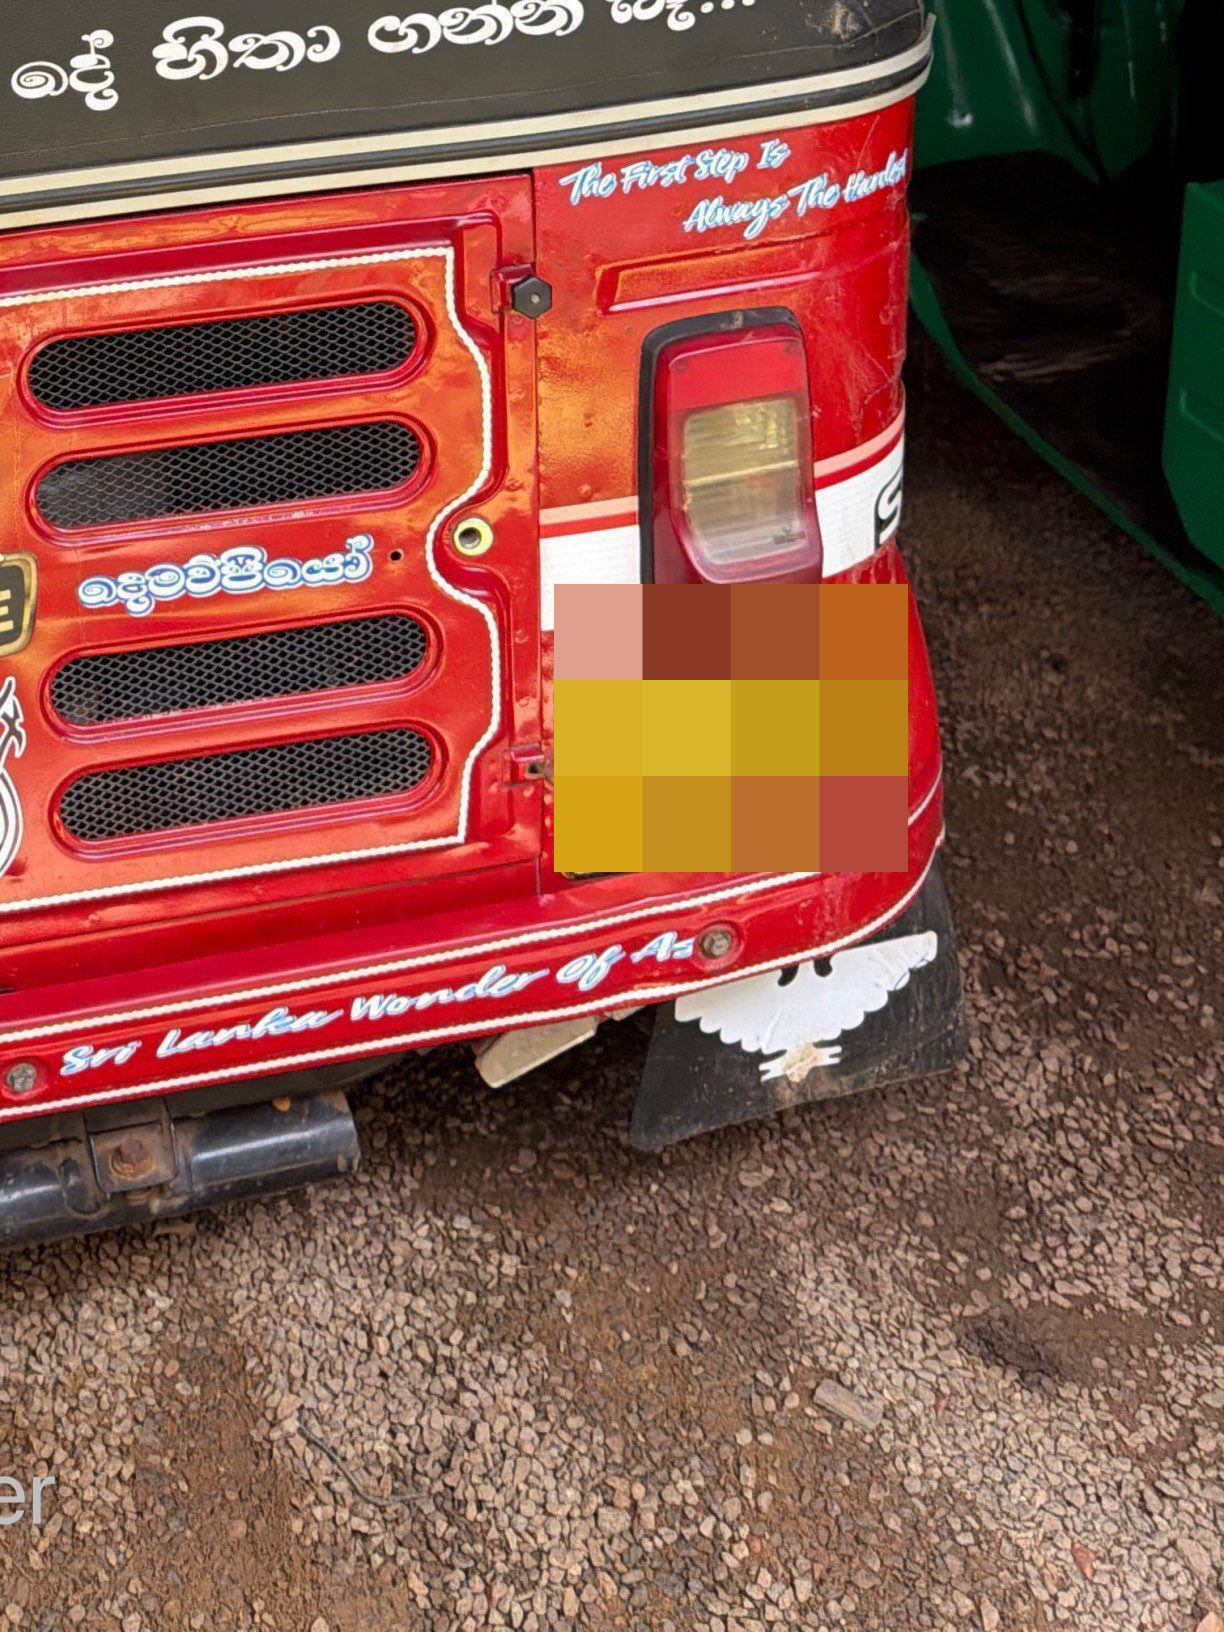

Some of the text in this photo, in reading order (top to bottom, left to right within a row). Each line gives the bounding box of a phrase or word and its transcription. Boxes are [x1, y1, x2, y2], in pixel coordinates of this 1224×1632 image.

[10, 29, 120, 112] දේ
[152, 16, 341, 80] හිතා
[559, 138, 791, 206] The First Step Is
[682, 194, 792, 241] Always
[787, 172, 839, 217] The
[59, 1039, 143, 1078] Sri
[154, 1006, 345, 1059] Lanka
[349, 962, 549, 1022] Wonder
[554, 942, 626, 992] Of
